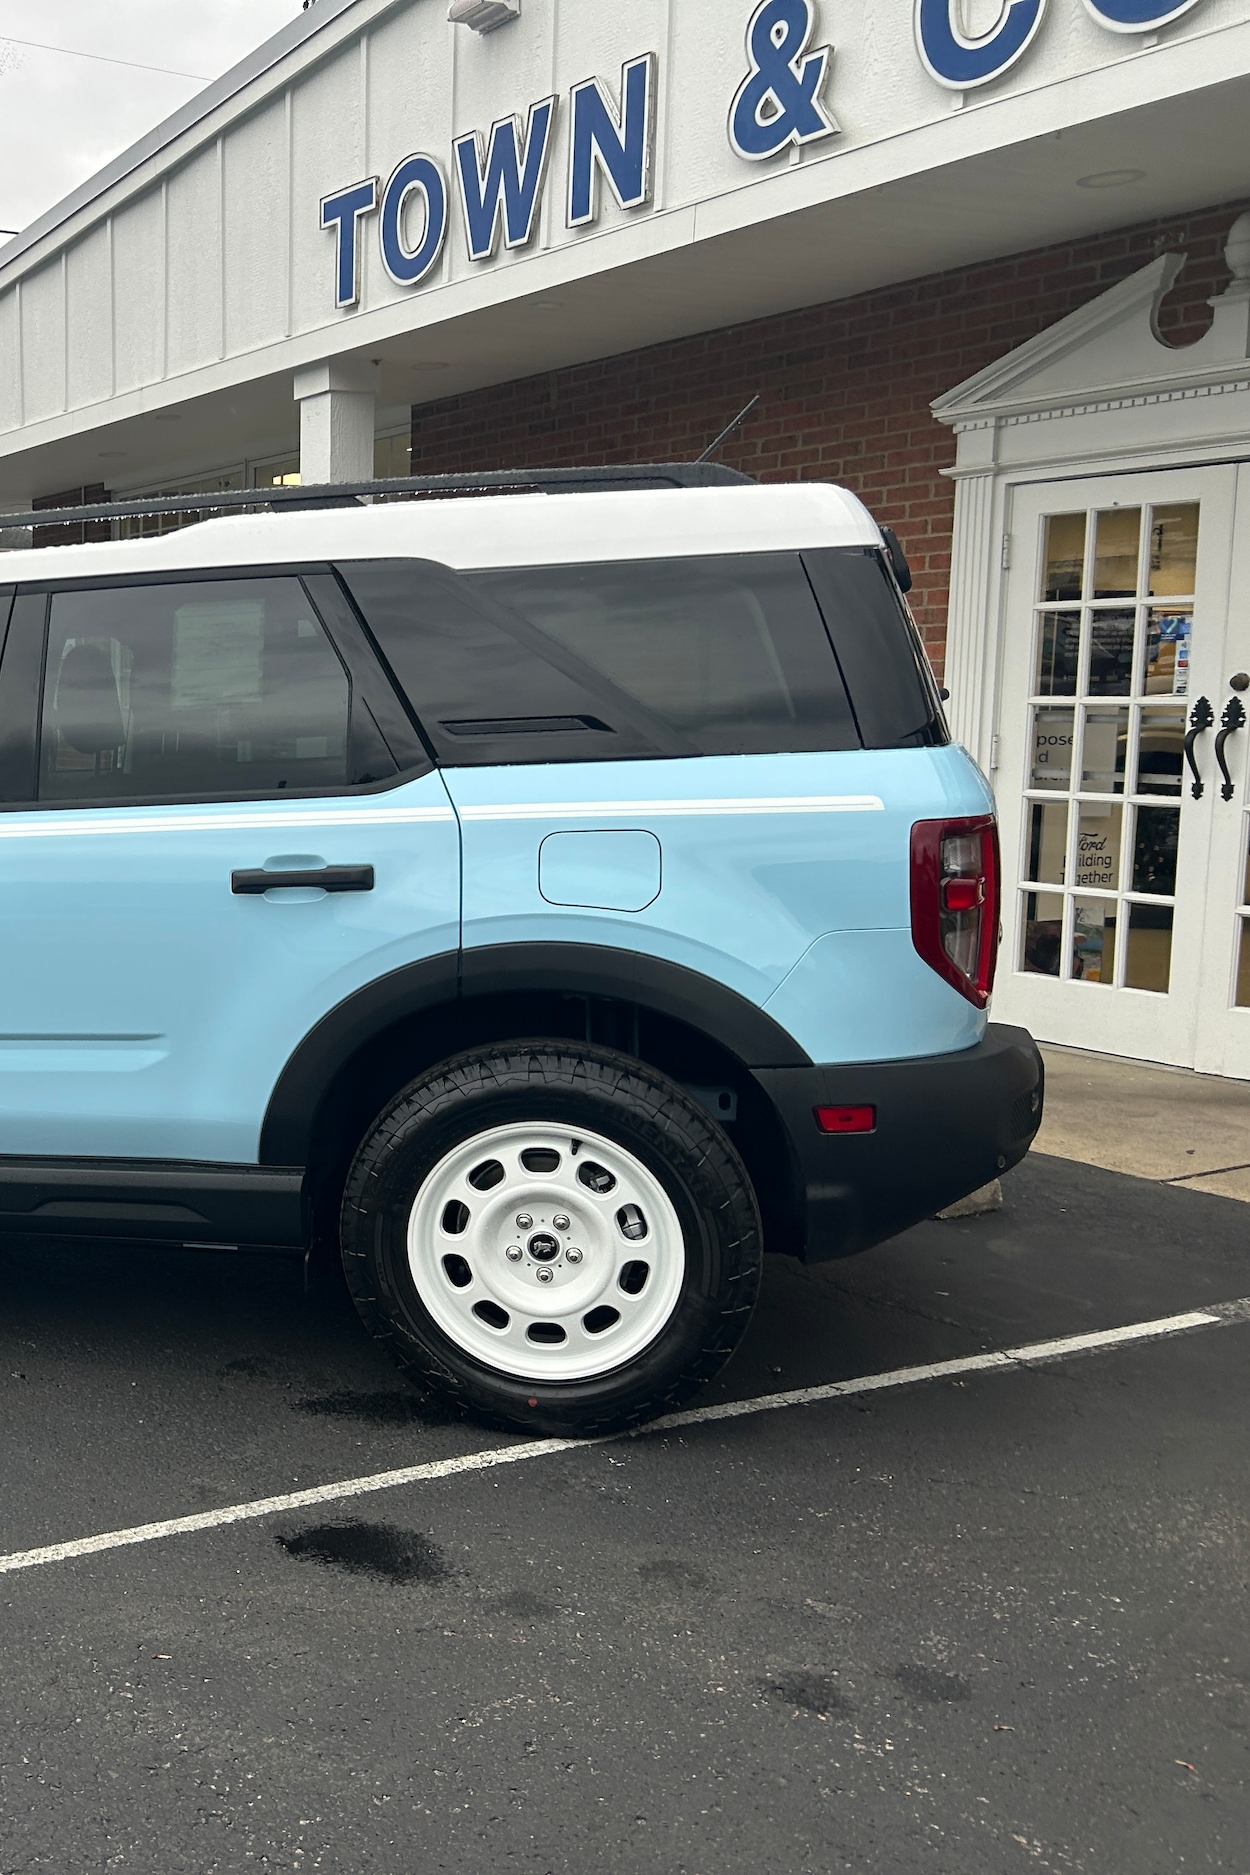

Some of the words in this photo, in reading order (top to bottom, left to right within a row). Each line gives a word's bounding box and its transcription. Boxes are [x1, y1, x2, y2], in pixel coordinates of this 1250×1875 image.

[320, 51, 658, 308] TOWN
[726, 0, 841, 163] &
[1079, 832, 1107, 851] Ford
[1060, 872, 1114, 887] Tgether
